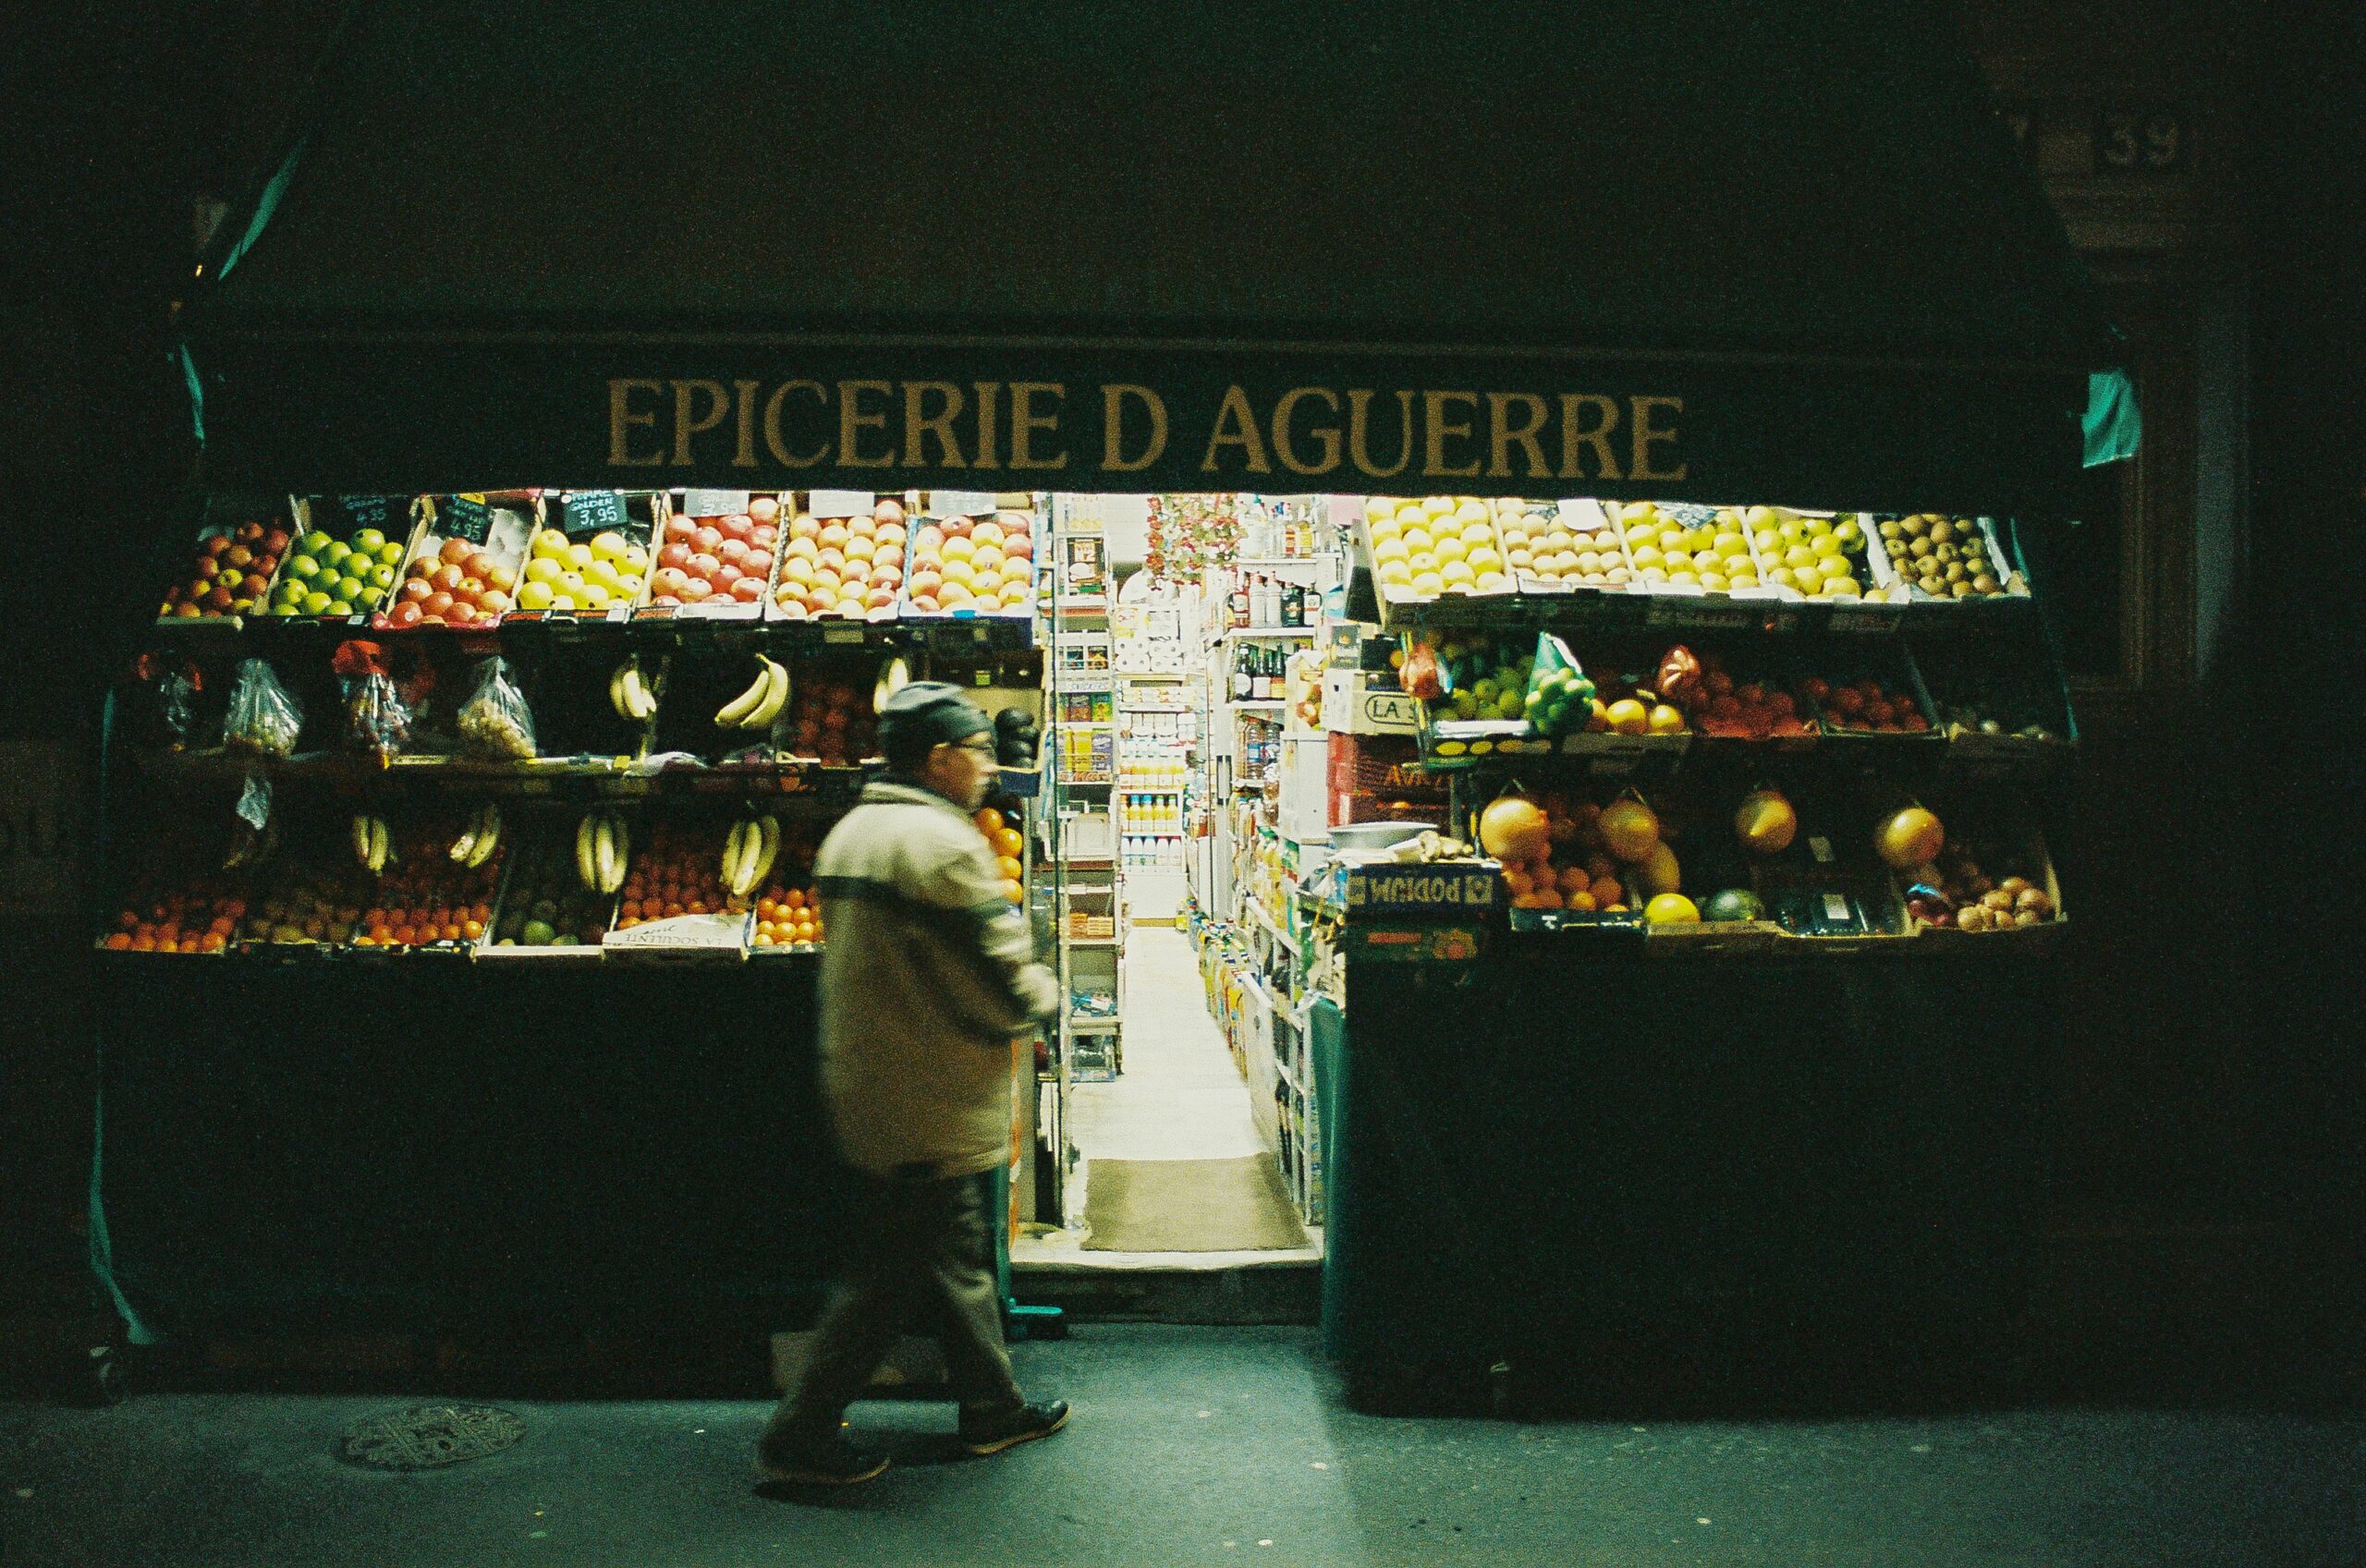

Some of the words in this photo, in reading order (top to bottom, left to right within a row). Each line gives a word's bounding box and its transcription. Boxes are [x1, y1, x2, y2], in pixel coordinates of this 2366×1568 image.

[2105, 114, 2178, 166] 39
[606, 379, 1068, 468] EPICERIE
[1099, 383, 1168, 472] D
[1201, 383, 1688, 481] AGUERRE
[570, 497, 614, 511] GOLDEN
[1372, 699, 1400, 718] LA
[1370, 876, 1461, 903] PODIUM
